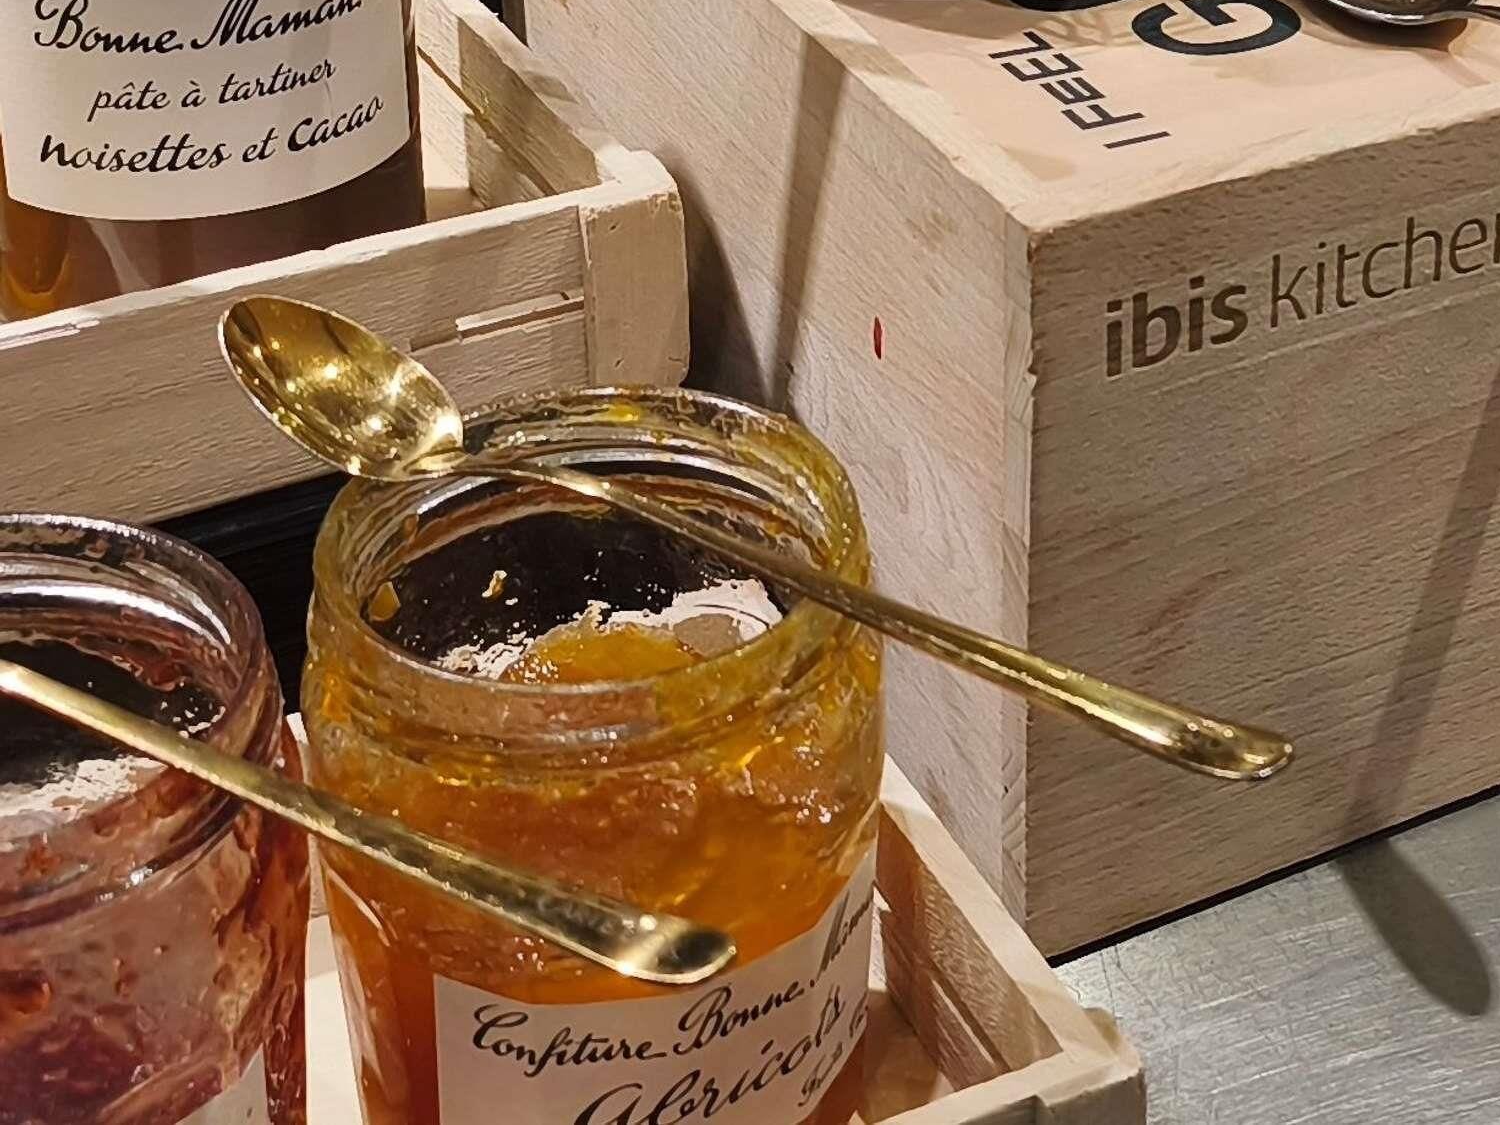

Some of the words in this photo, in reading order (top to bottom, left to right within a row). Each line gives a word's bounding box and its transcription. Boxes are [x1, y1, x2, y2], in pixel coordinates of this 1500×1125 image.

[86, 81, 172, 122] pâte
[181, 80, 206, 109] à
[217, 58, 337, 105] tartiner
[988, 31, 1145, 131] FEEL
[242, 128, 277, 162] et
[1106, 276, 1249, 377] ibis
[473, 1004, 668, 1077] Confiture
[672, 981, 805, 1056] Bonne
